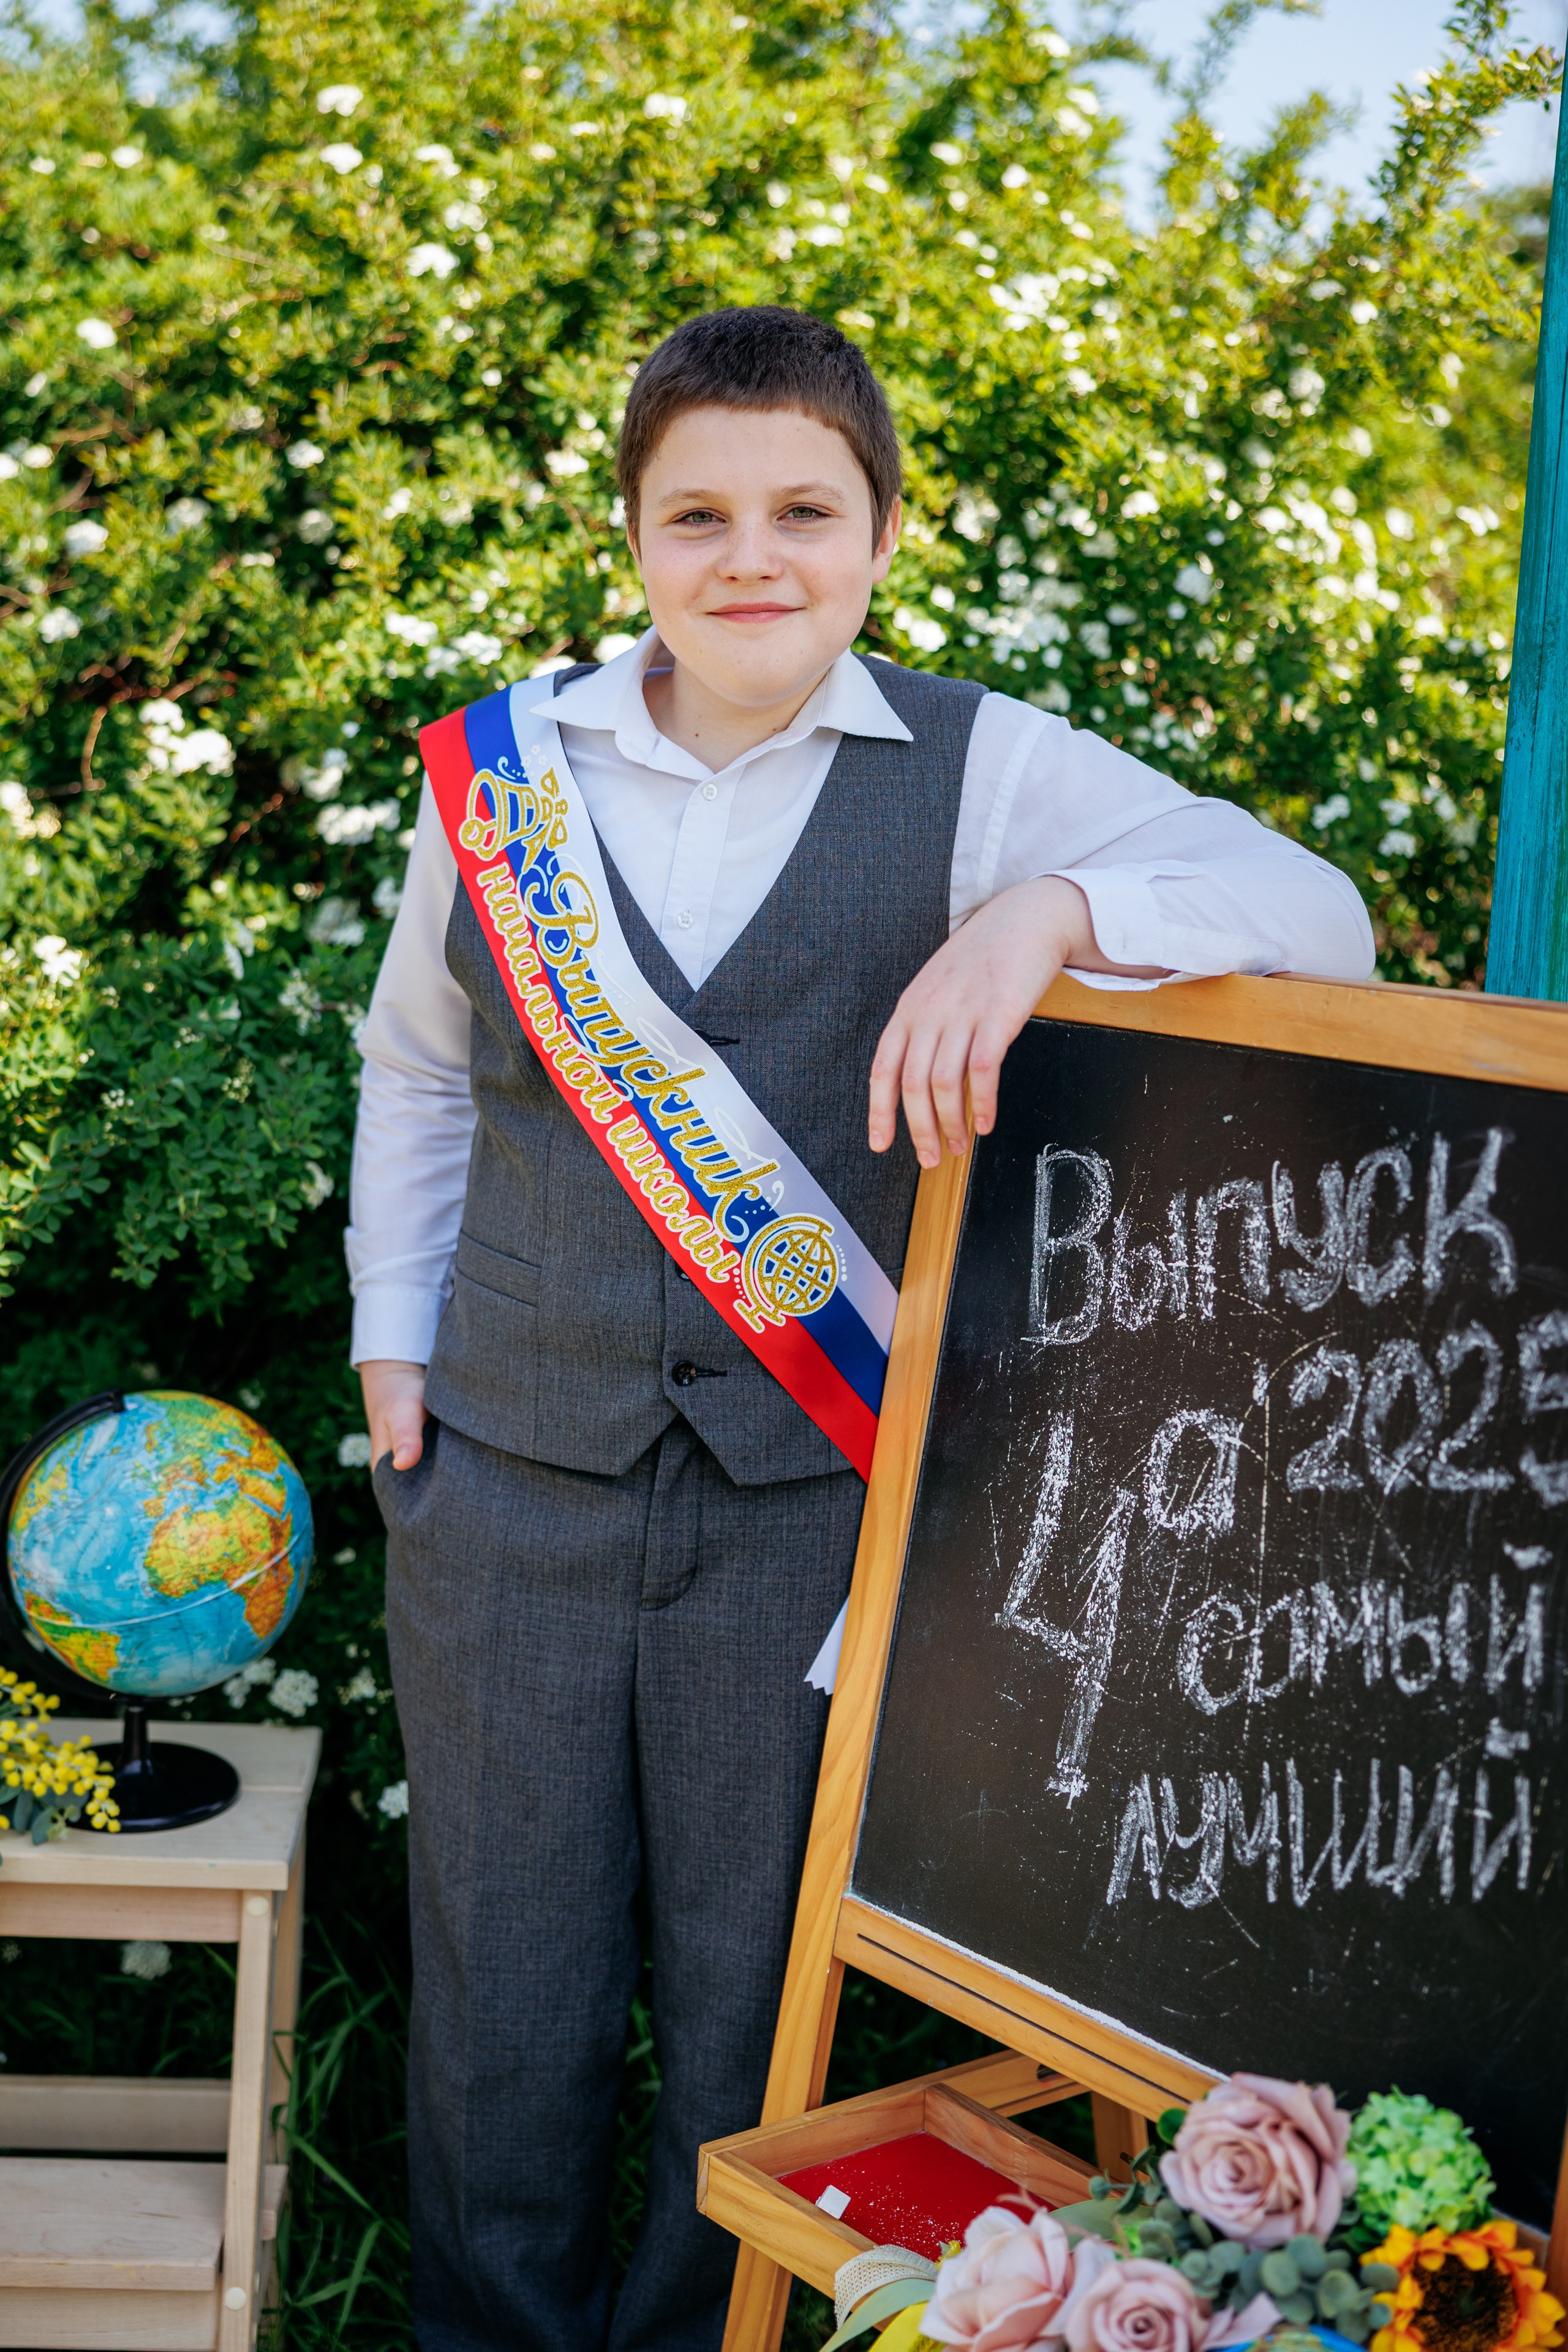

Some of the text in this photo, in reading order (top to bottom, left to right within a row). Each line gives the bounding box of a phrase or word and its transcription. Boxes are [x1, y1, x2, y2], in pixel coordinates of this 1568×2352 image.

[478, 861, 741, 1284] начальной школы
[522, 867, 781, 1243] Выпускник
[1022, 1128, 1517, 1346] Выпуск
[1176, 1542, 1553, 1716] самый
